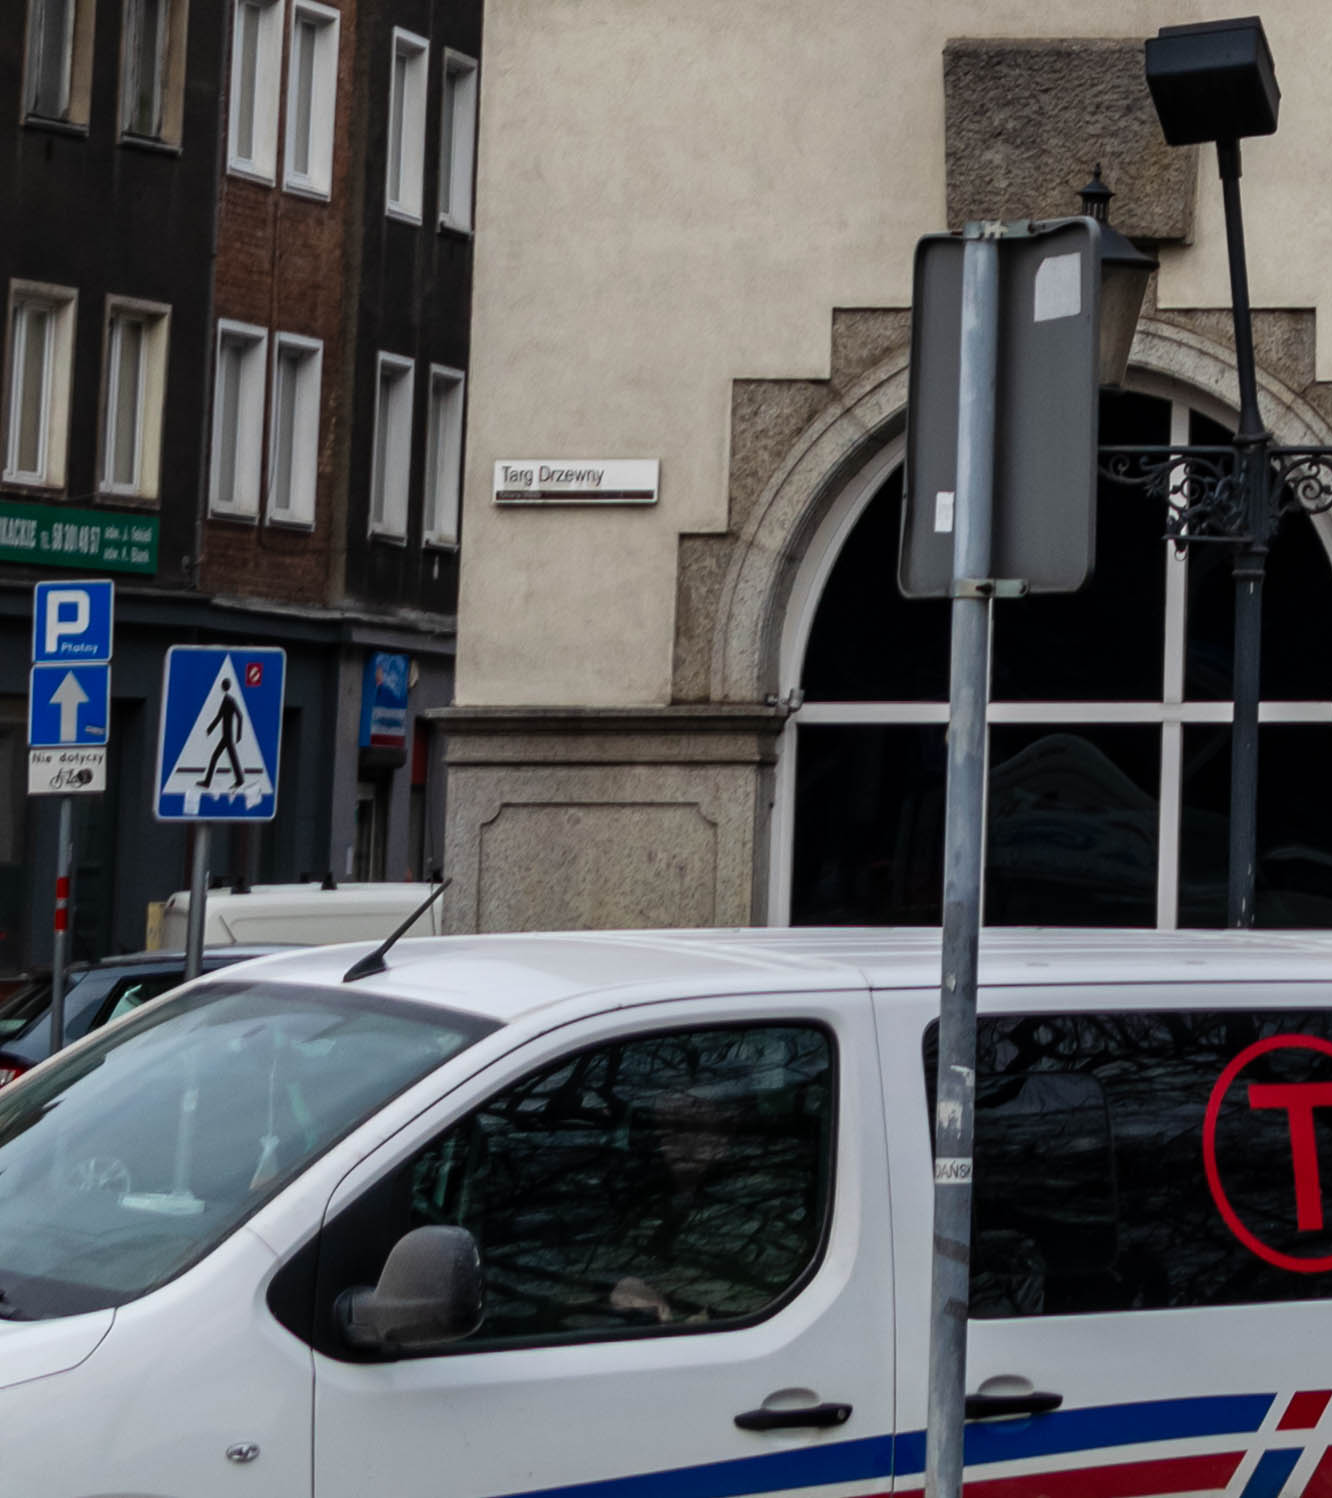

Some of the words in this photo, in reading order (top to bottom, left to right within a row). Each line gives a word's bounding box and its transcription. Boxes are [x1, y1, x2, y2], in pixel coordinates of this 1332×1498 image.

[502, 466, 534, 486] Targ
[539, 466, 605, 486] Drzewny
[45, 590, 90, 653] P
[32, 752, 52, 764] Nie
[59, 750, 104, 765] dotyczy
